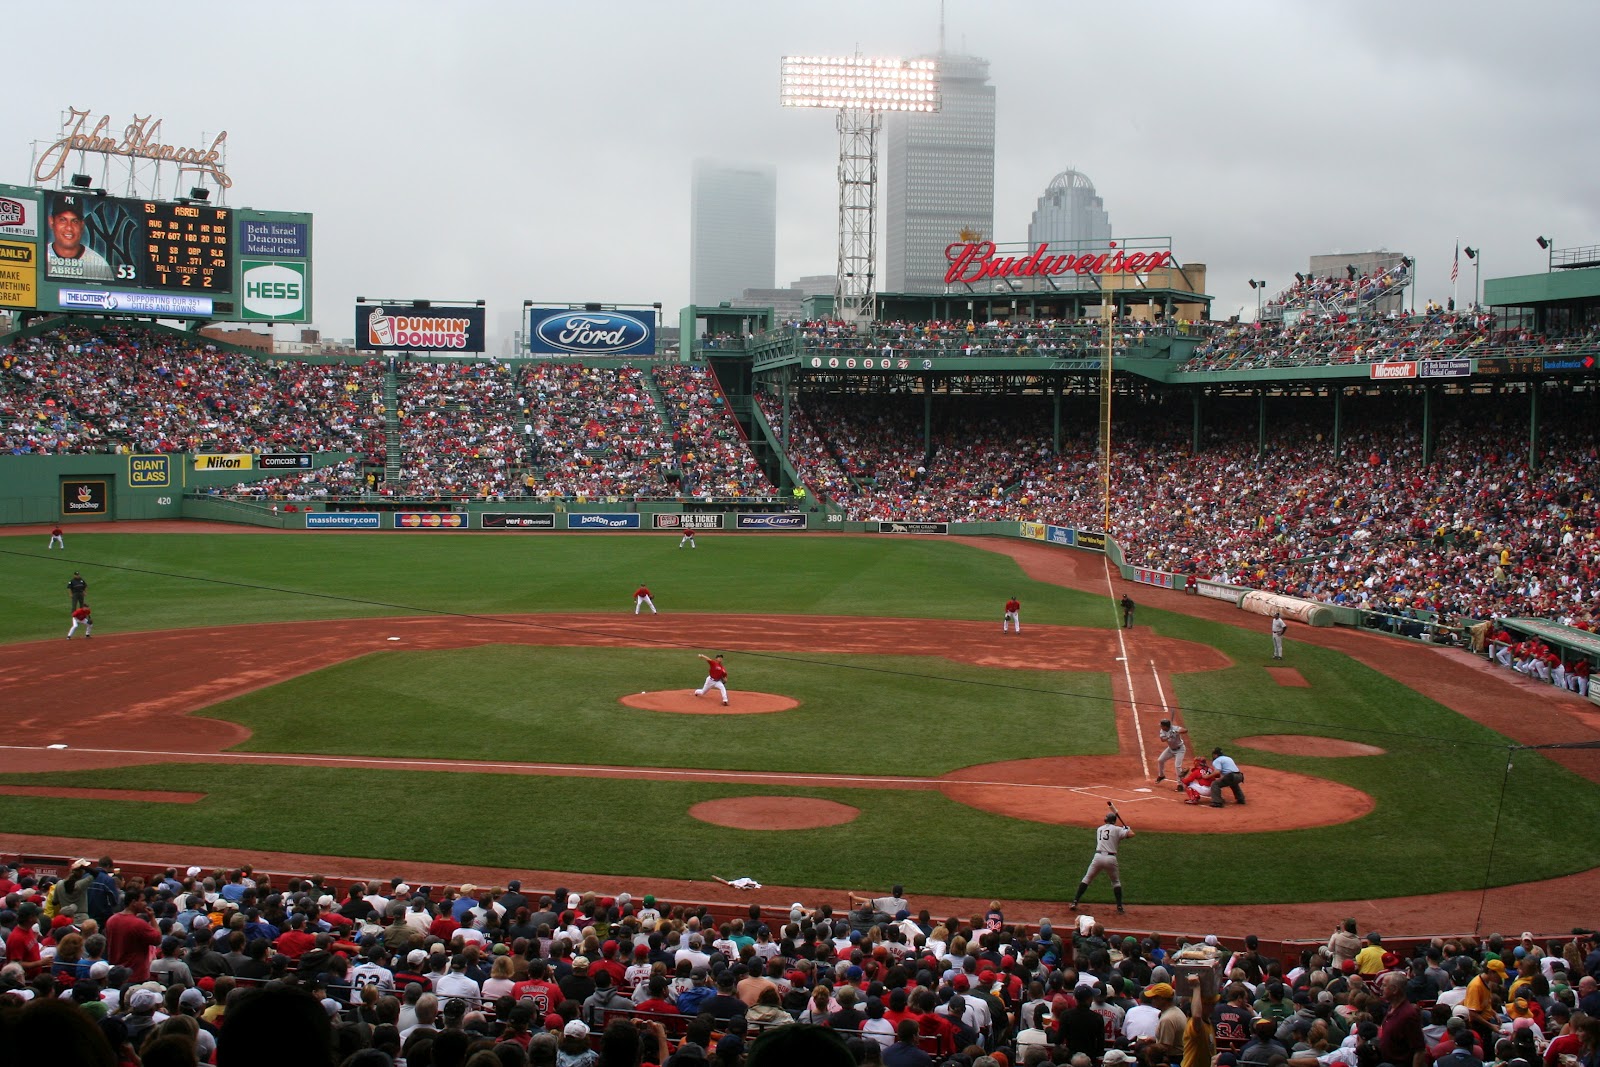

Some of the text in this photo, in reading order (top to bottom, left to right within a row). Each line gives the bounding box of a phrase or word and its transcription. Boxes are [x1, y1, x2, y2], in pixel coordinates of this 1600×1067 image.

[34, 106, 232, 188] John Hancock
[0, 202, 19, 214] CE
[145, 203, 156, 213] 53
[216, 210, 227, 220] RF
[148, 220, 162, 228] AVG
[200, 225, 210, 233] HR
[213, 225, 226, 234] RBI
[247, 224, 296, 235] Beth Israel
[149, 231, 166, 239] .297
[167, 232, 181, 240] 607
[200, 235, 210, 243] 20
[247, 234, 297, 244] Deaconess
[169, 246, 178, 254] SB
[188, 247, 201, 255] OBP
[210, 249, 224, 257] SLG
[247, 244, 301, 254] Medical Center
[51, 258, 84, 267] BOBBY
[150, 254, 226, 267] 71 21 .371 .473
[944, 240, 1172, 284] Budweiser
[50, 266, 83, 276] ABREU
[117, 265, 136, 279] 53
[156, 264, 171, 273] BALL
[176, 266, 198, 275] STRIKE
[162, 273, 212, 287] 1 2 2
[247, 281, 299, 299] HESS
[126, 294, 200, 306] SUPPORTING OUR 351
[173, 305, 197, 313] TOWNS
[396, 317, 470, 333] DUNKIN'
[558, 316, 627, 345] Ford
[396, 332, 466, 347] DONUTS
[830, 359, 837, 367] 4
[848, 360, 854, 368] 6
[865, 360, 871, 368] 8
[883, 360, 889, 368] 9
[897, 360, 910, 369] 27
[1544, 361, 1556, 369] Bank
[1374, 363, 1410, 378] Microsoft
[133, 460, 165, 471] GIANT
[206, 456, 241, 468] Nikon
[265, 457, 296, 465] comcast
[133, 471, 166, 482] GLASS
[157, 497, 171, 505] 420
[308, 516, 377, 525] masslottery.com
[680, 515, 694, 523] ACE
[694, 515, 718, 523] TICKET
[827, 514, 842, 522] 380
[1099, 829, 1110, 841] 13
[355, 974, 380, 991] 62
[520, 994, 549, 1016] 3
[1216, 1022, 1246, 1038] 34
